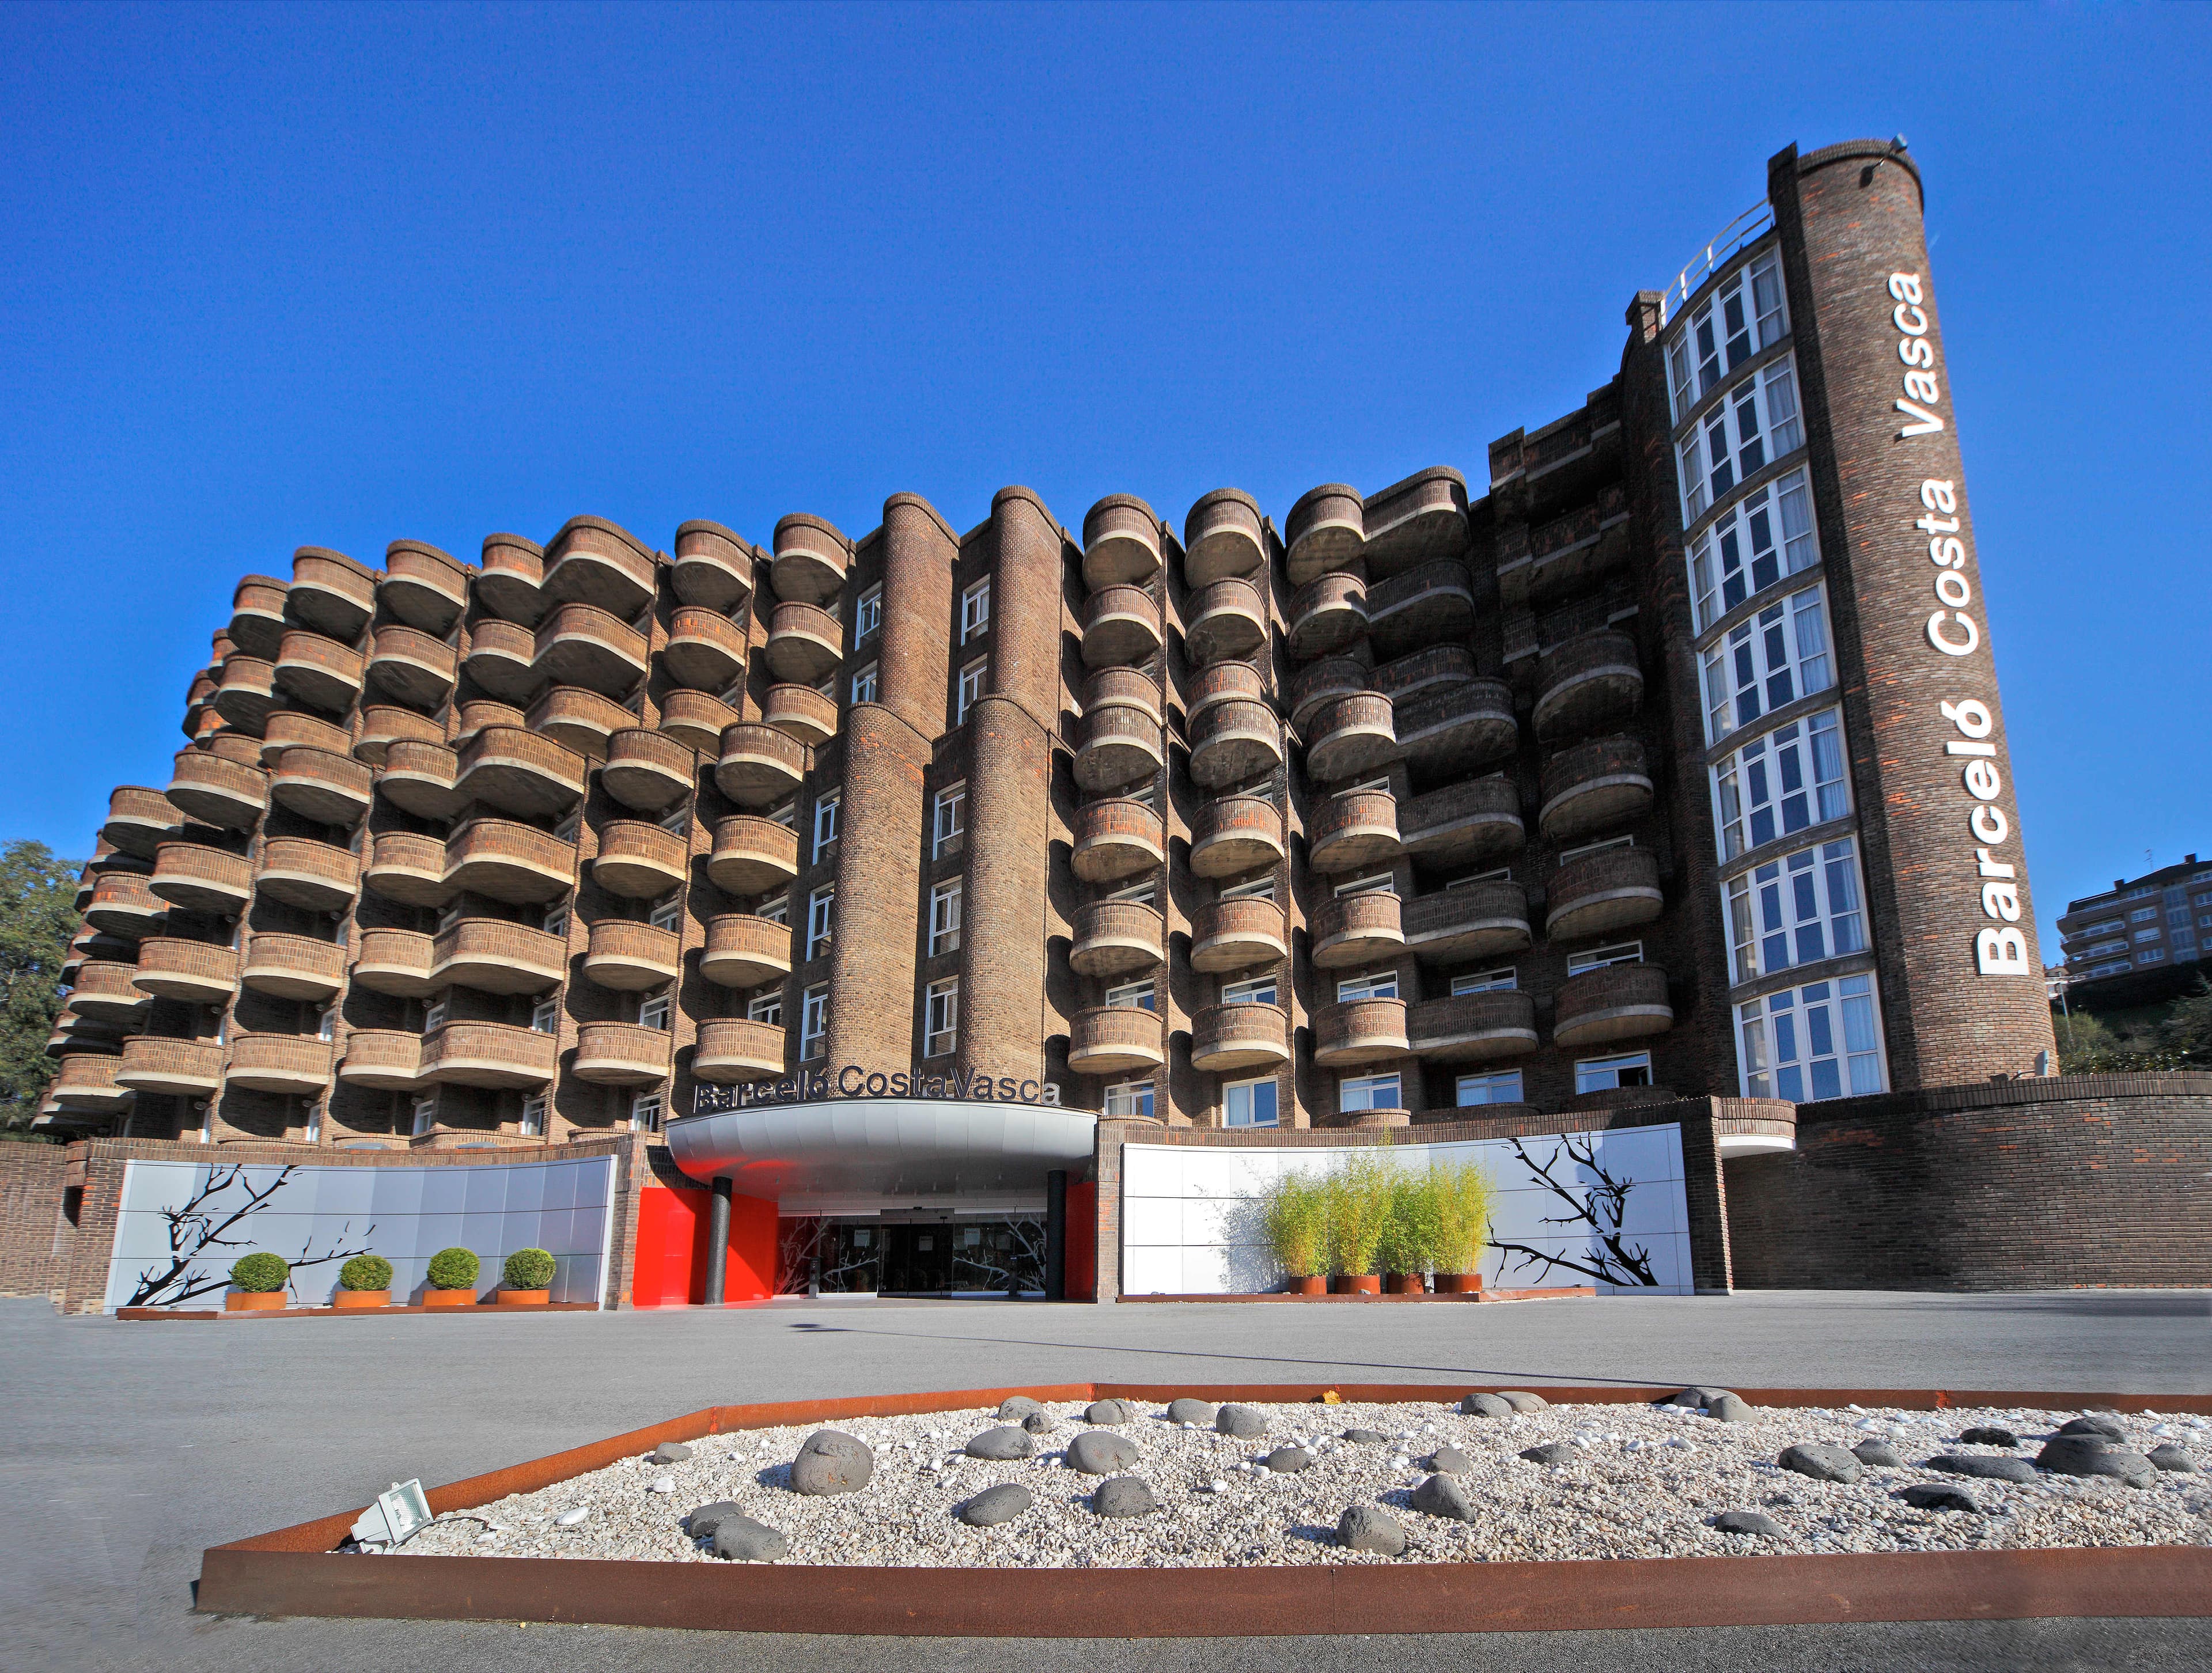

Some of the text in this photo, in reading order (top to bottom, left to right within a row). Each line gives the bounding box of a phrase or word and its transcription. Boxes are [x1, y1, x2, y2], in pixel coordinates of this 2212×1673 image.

[1888, 271, 2031, 976] Barceló Costa Vasca
[693, 1067, 831, 1114] Barceló
